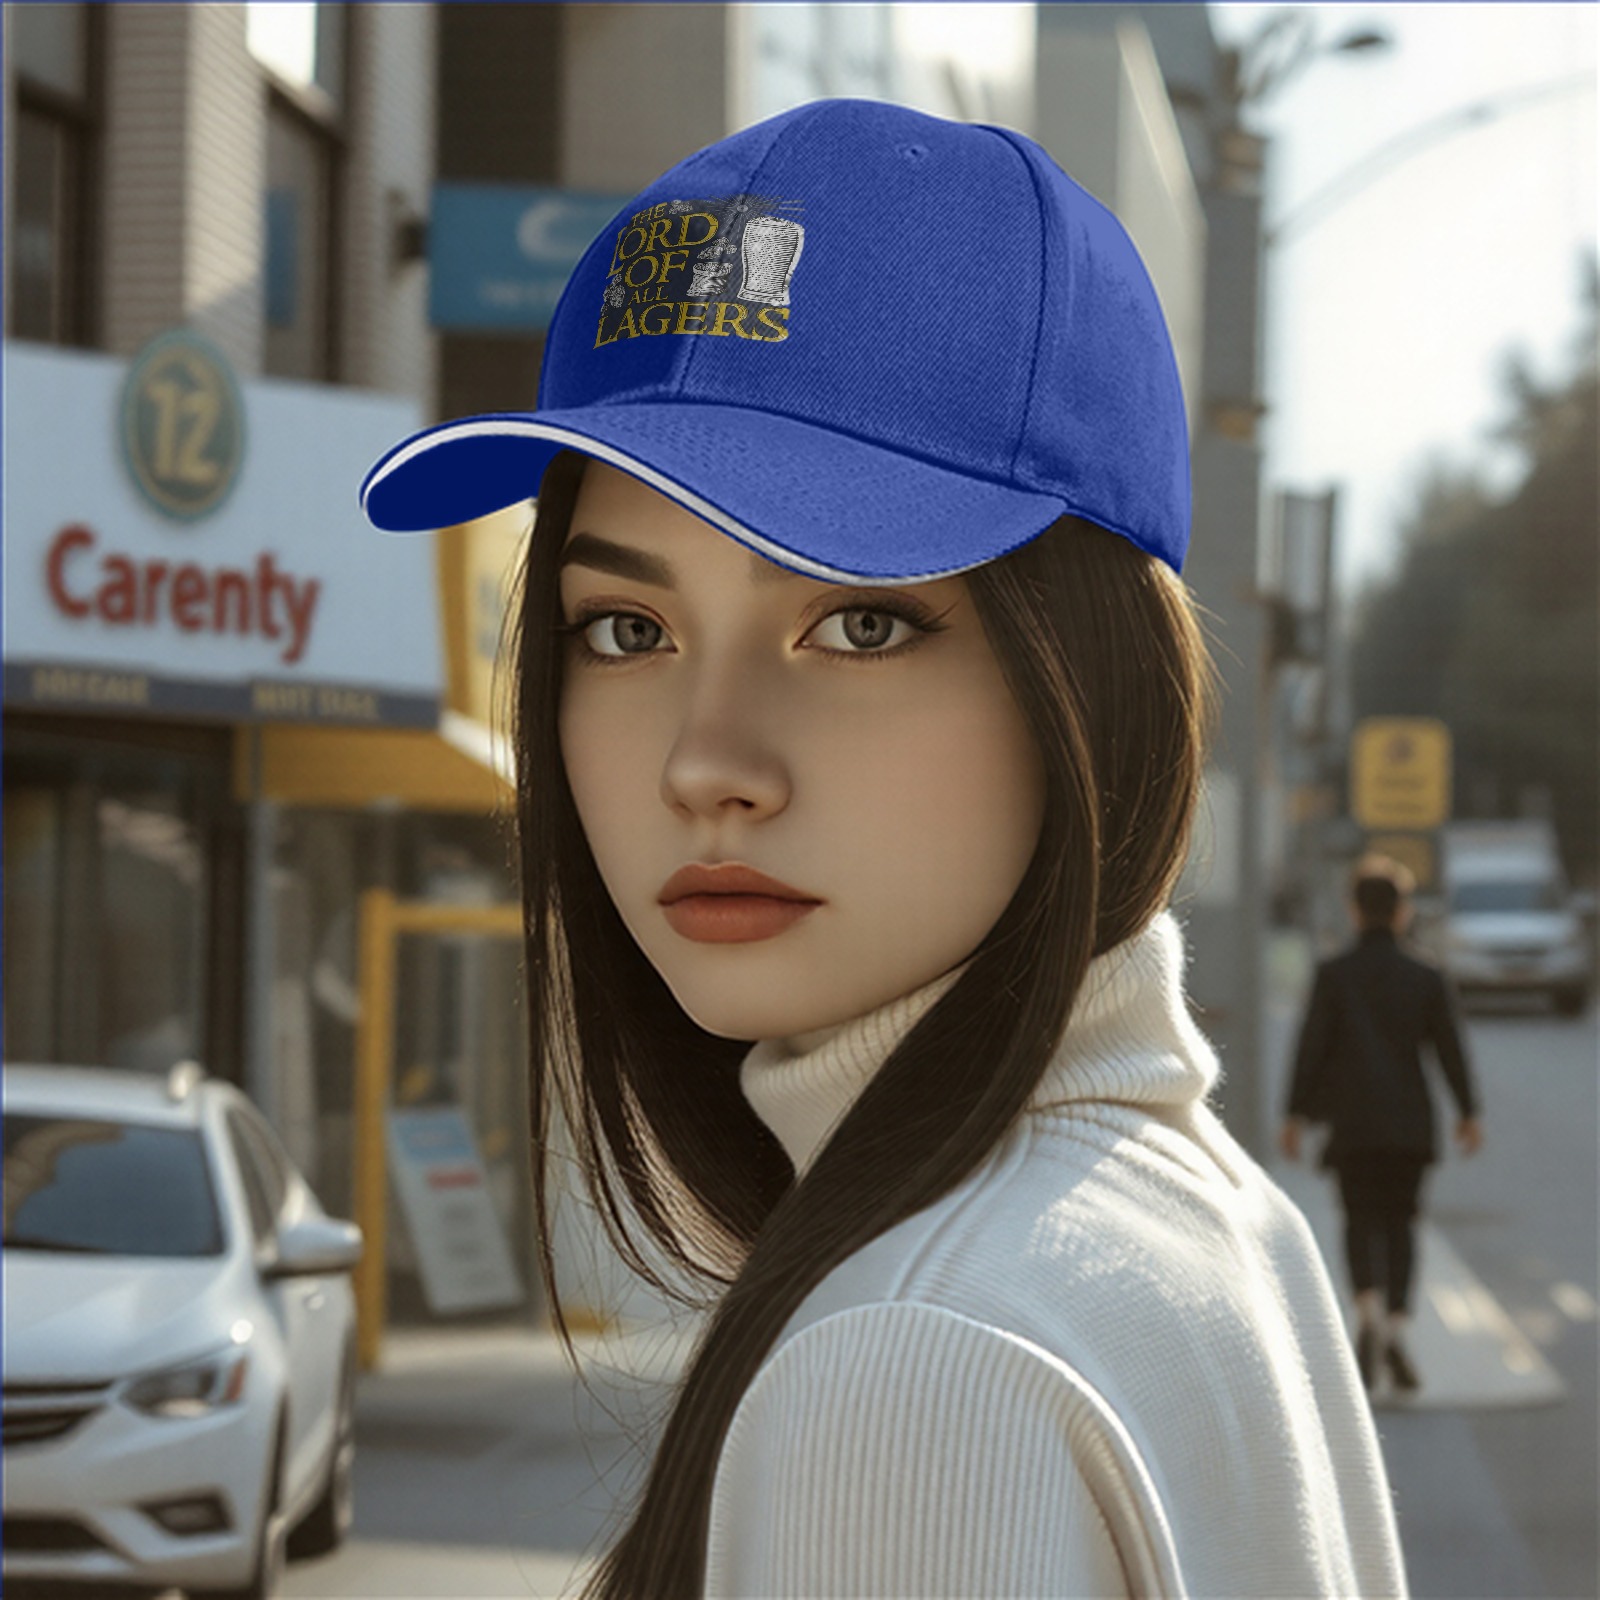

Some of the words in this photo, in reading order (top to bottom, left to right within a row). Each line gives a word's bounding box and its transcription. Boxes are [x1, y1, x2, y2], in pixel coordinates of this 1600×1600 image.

[631, 203, 668, 226] THE
[606, 213, 719, 279] LORD
[625, 250, 690, 288] OF
[628, 286, 669, 305] ALL
[593, 302, 790, 349] LAGERS
[45, 524, 320, 664] Carenty
